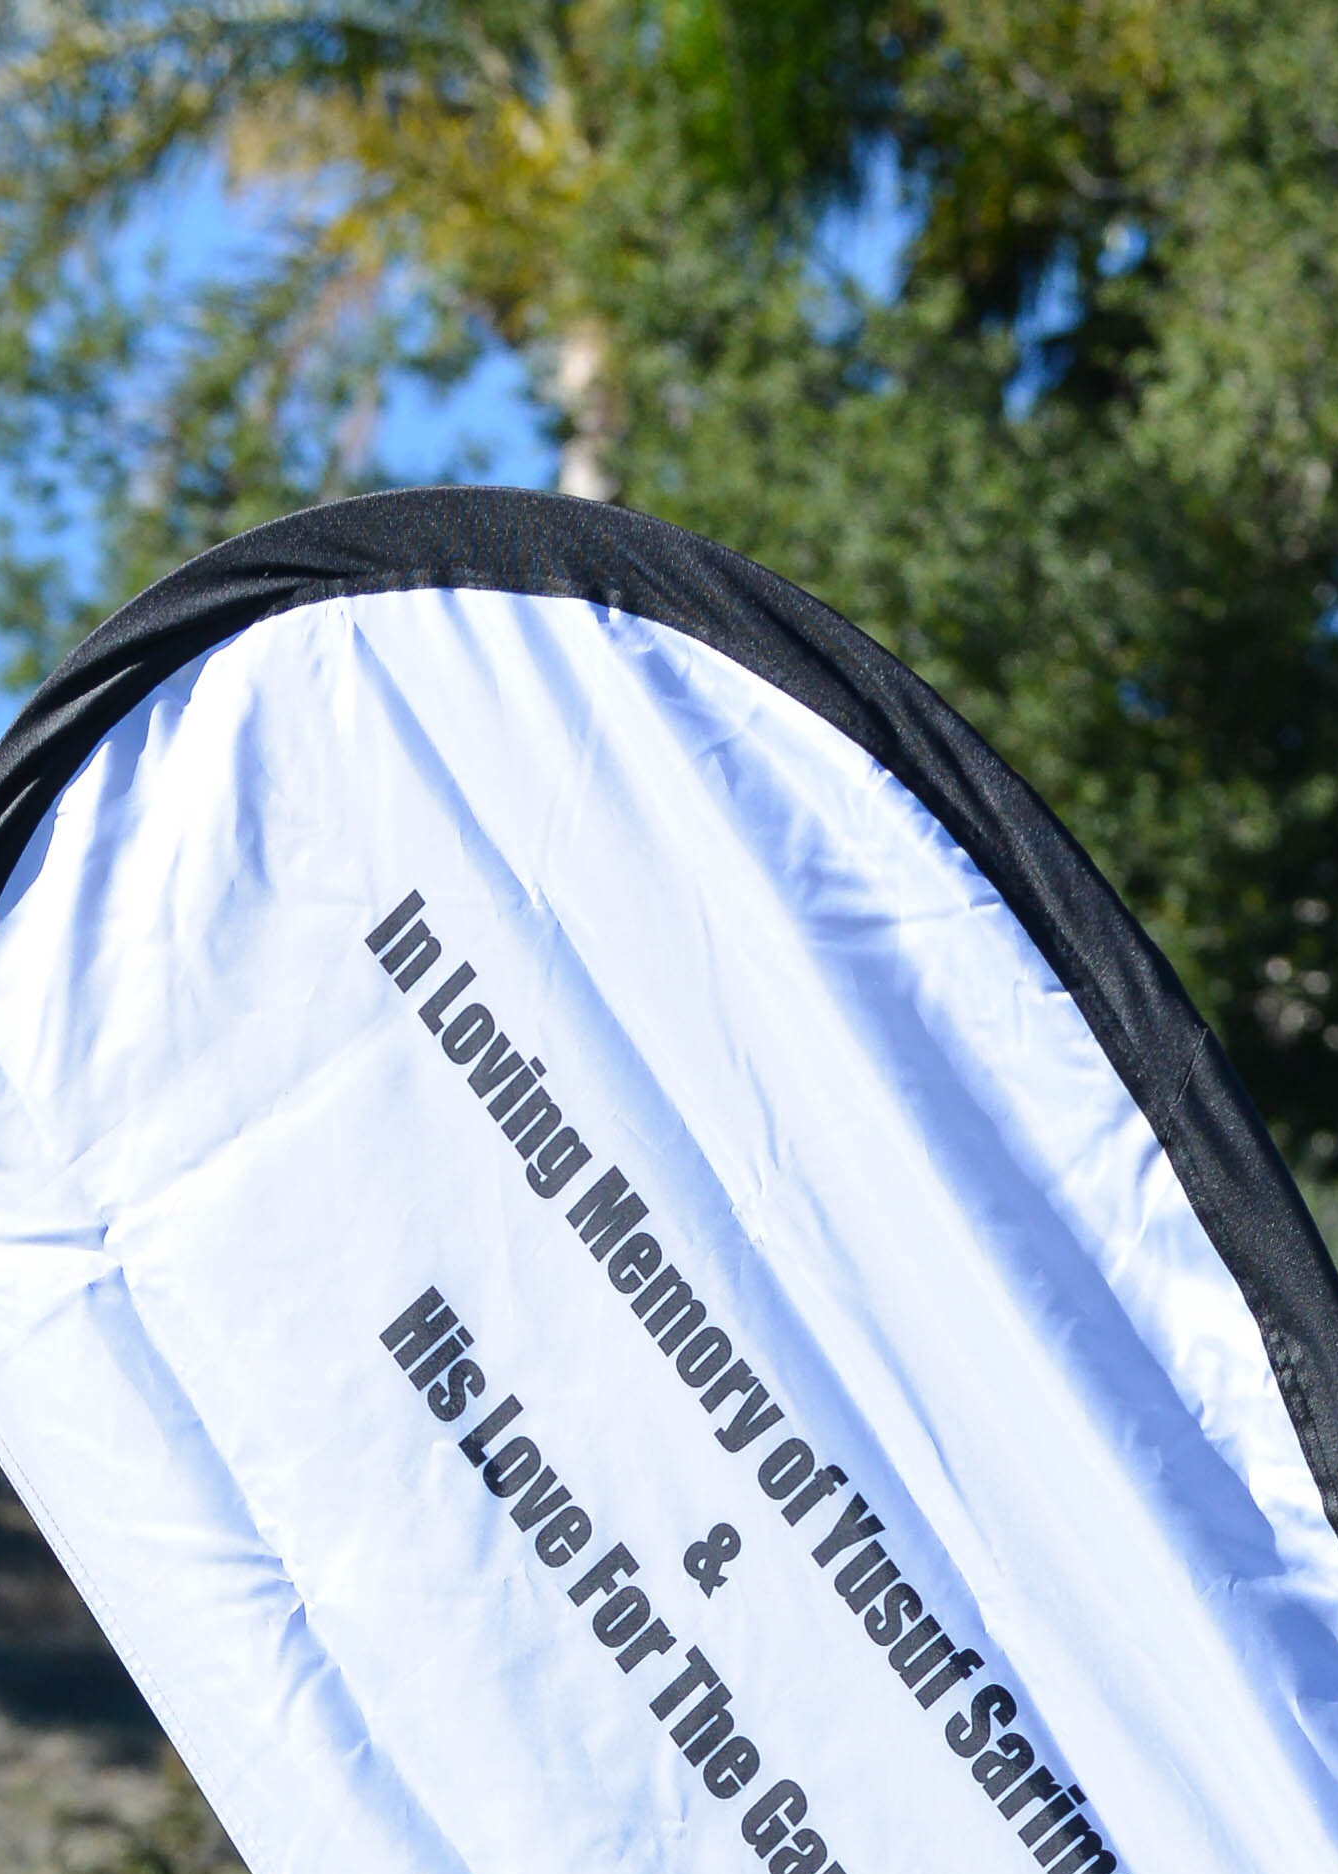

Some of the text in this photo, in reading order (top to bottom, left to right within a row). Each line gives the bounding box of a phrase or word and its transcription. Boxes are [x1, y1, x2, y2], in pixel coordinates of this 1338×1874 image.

[364, 889, 442, 994] In
[418, 962, 592, 1199] Loving
[566, 1165, 783, 1454] Memory
[758, 1437, 849, 1527] of
[810, 1492, 985, 1710] Yusuf
[379, 1286, 486, 1423] His
[457, 1395, 593, 1568] Love
[566, 1541, 678, 1674] For
[649, 1646, 761, 1800] The
[683, 1522, 742, 1598] &
